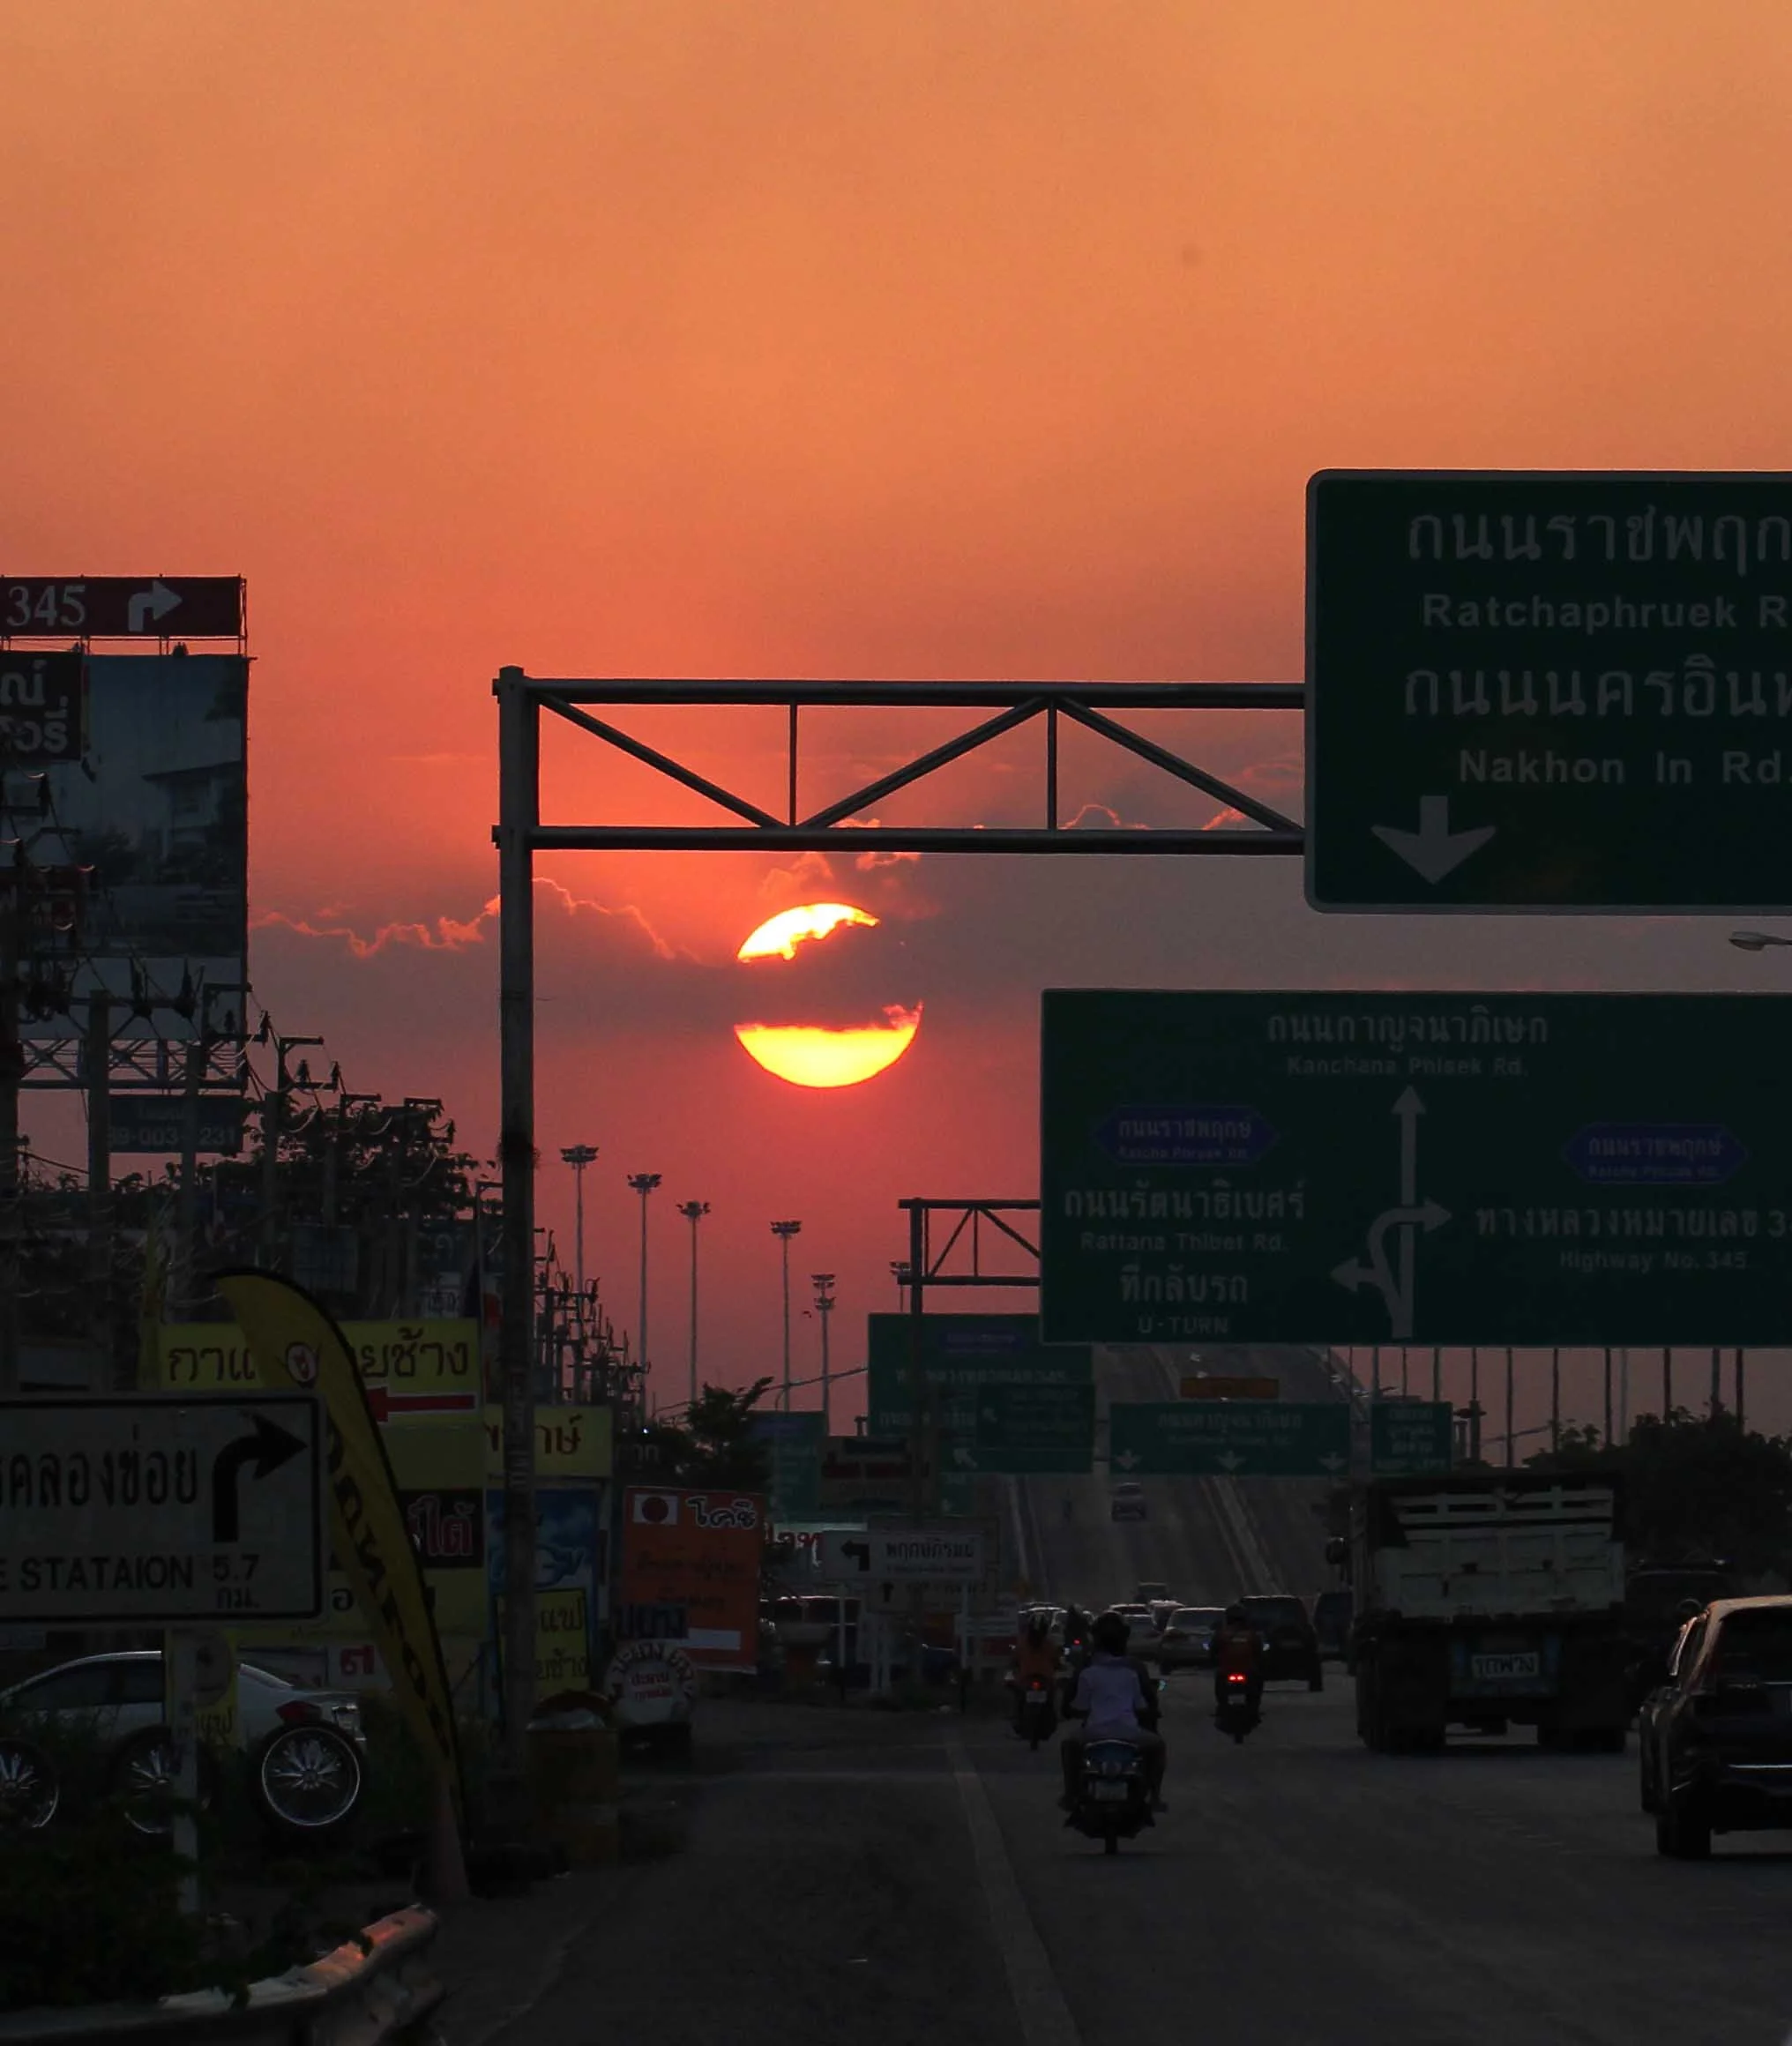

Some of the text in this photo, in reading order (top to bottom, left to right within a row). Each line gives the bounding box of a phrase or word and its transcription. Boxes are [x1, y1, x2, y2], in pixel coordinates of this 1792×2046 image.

[6, 585, 86, 627] 345
[1422, 593, 1737, 634] Ratchaphruek
[1460, 749, 1626, 784] Nakhon
[1655, 750, 1692, 783] In
[1287, 1057, 1396, 1075] Kanchana
[1492, 1057, 1528, 1076] Rd.
[1767, 1209, 1792, 1237] 3
[1560, 1251, 1749, 1273] Highway No. 345
[0, 1424, 198, 1508] คลองข่อย
[20, 1557, 193, 1591] STATAION
[213, 1555, 260, 1581] 5.7
